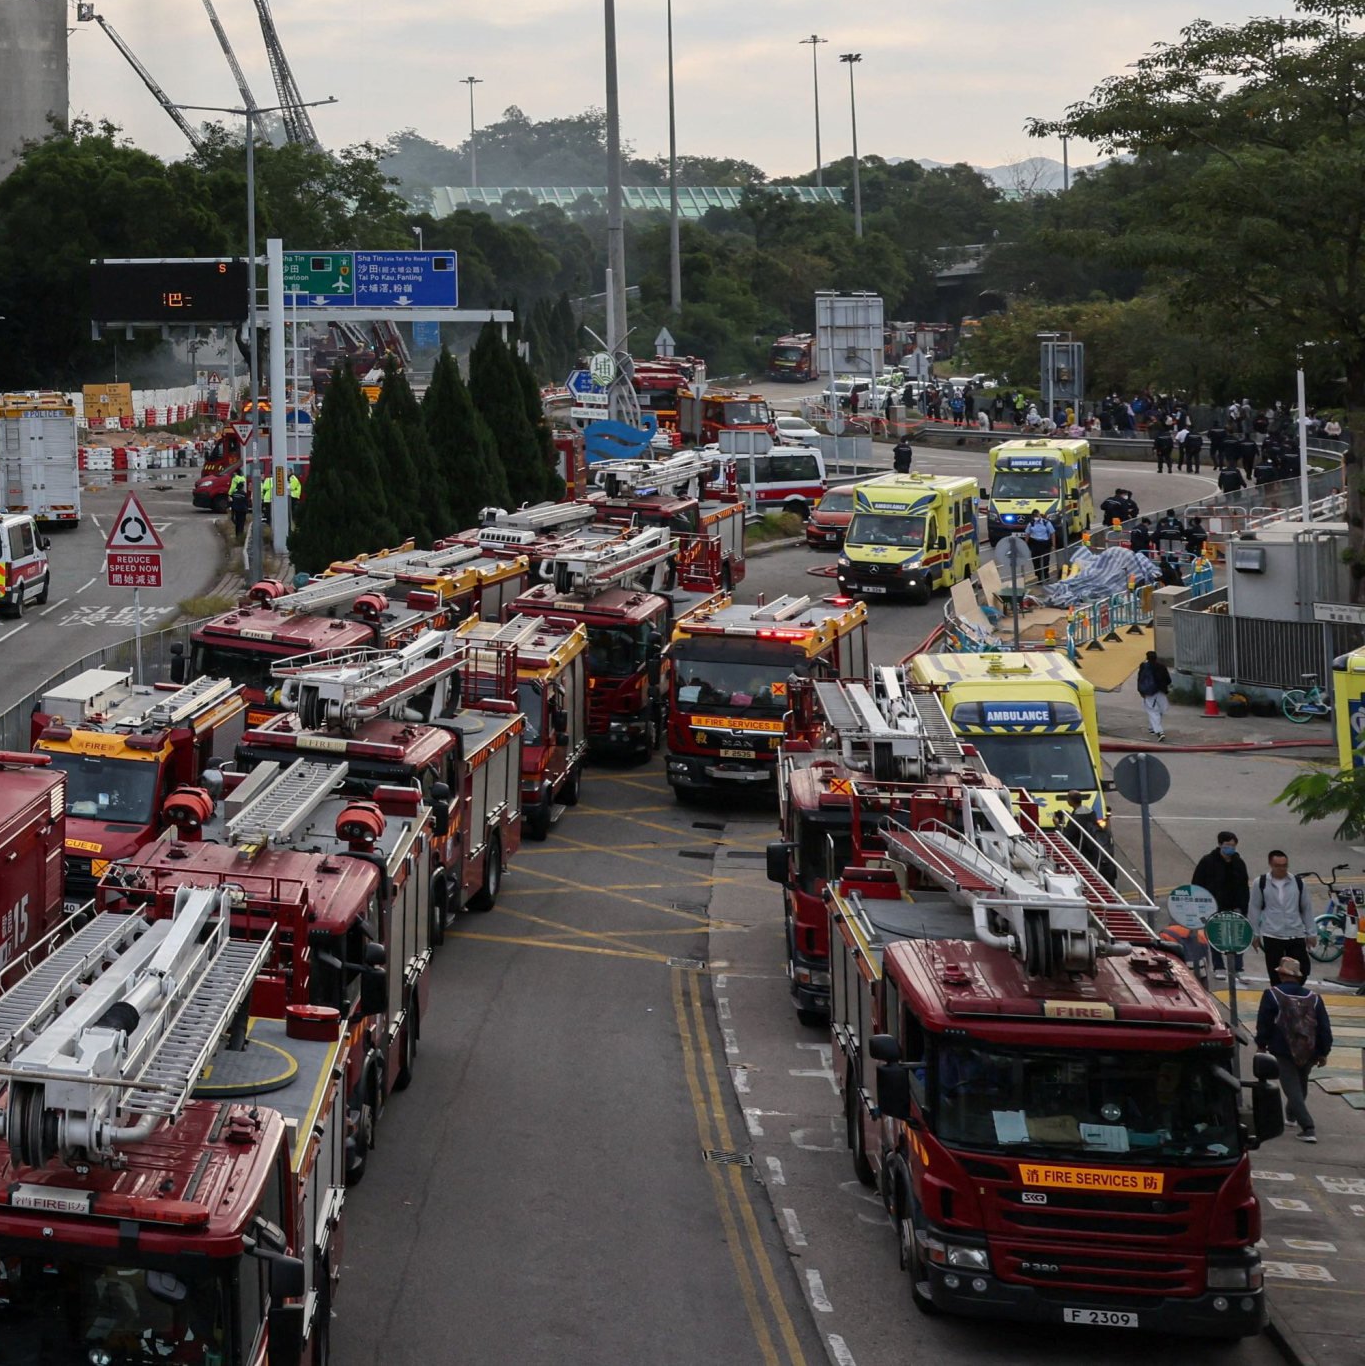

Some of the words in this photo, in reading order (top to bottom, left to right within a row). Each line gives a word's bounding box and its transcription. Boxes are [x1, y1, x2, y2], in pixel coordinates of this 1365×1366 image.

[874, 502, 907, 510] AMBULANCE
[987, 711, 1049, 721] AMBULANCE
[728, 721, 769, 730] SERVICES
[85, 742, 107, 751] FIRE
[14, 893, 29, 949] 15
[1056, 1006, 1103, 1018] FIRE
[1027, 1169, 1040, 1183] 消
[1044, 1171, 1073, 1184] FIRE
[1076, 1173, 1139, 1189] SERVICES
[1143, 1176, 1158, 1190] 防
[33, 1198, 67, 1211] FIRE
[1071, 1310, 1081, 1322] F
[1089, 1311, 1131, 1326] 2309
